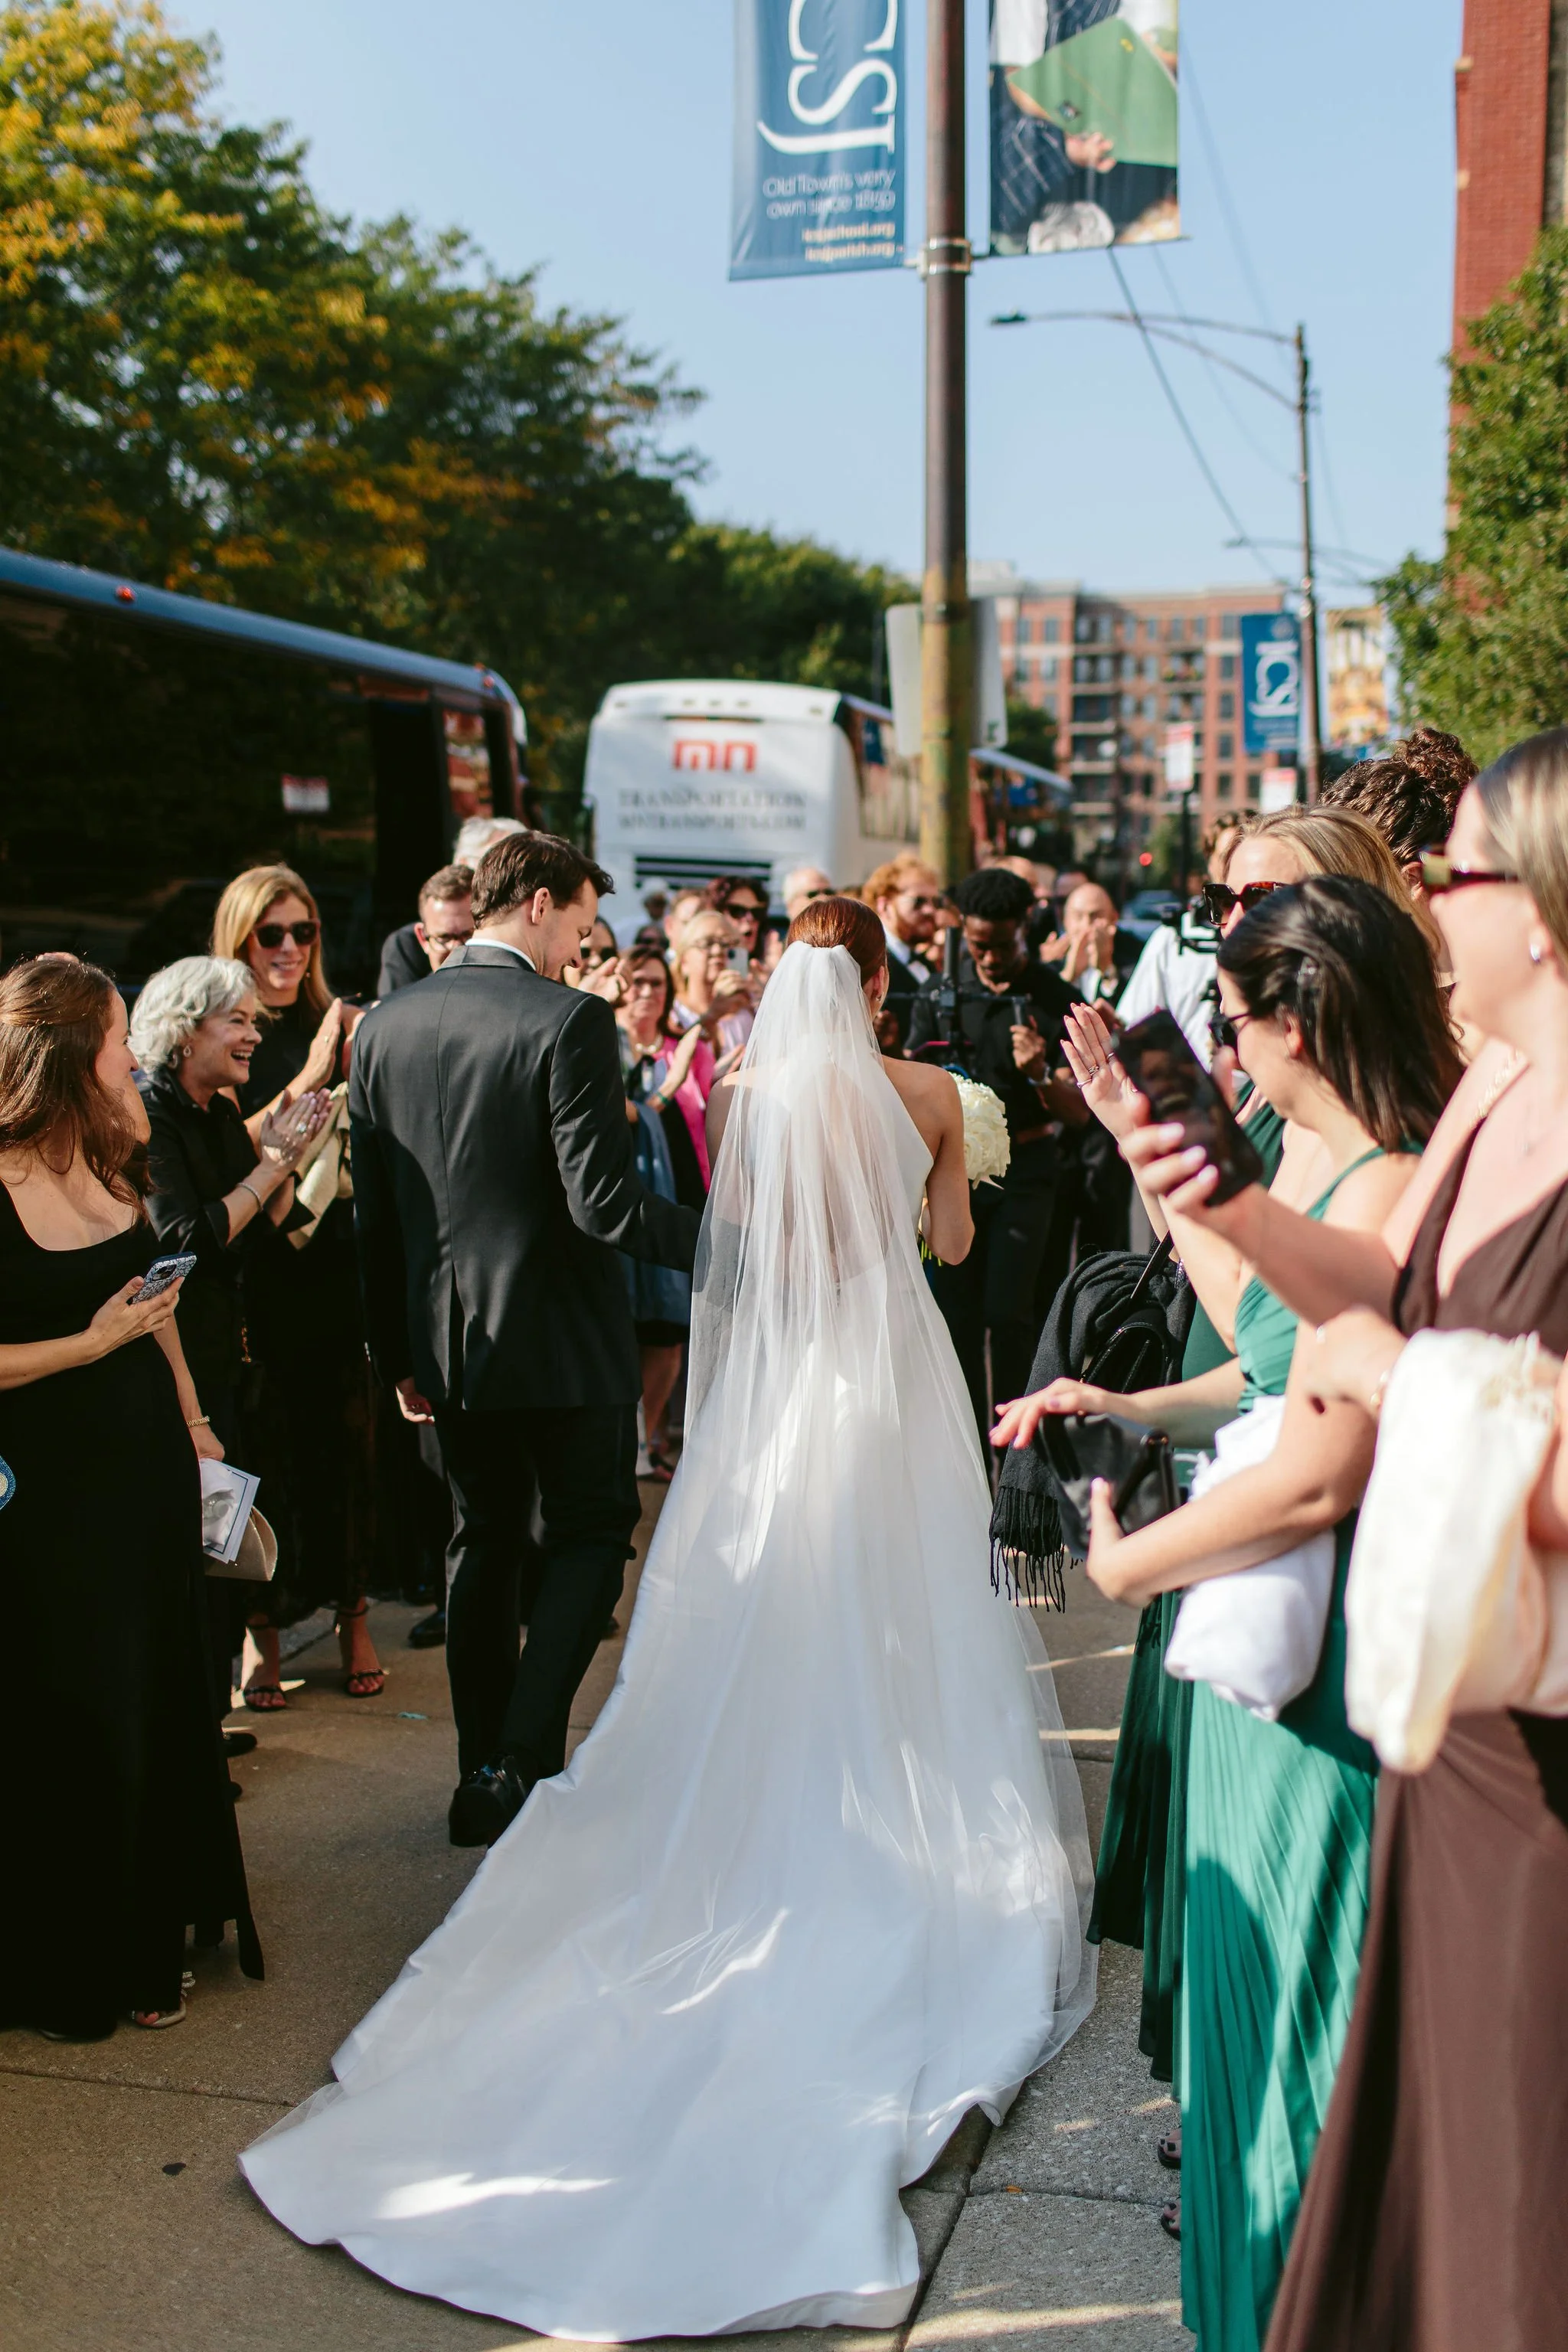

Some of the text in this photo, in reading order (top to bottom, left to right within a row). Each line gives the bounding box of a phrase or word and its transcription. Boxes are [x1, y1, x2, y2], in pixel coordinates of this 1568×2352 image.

[763, 176, 795, 198] Old
[854, 168, 897, 190] very
[766, 198, 806, 219] own
[808, 194, 852, 217] since
[619, 788, 807, 807] TRANSPORTATION
